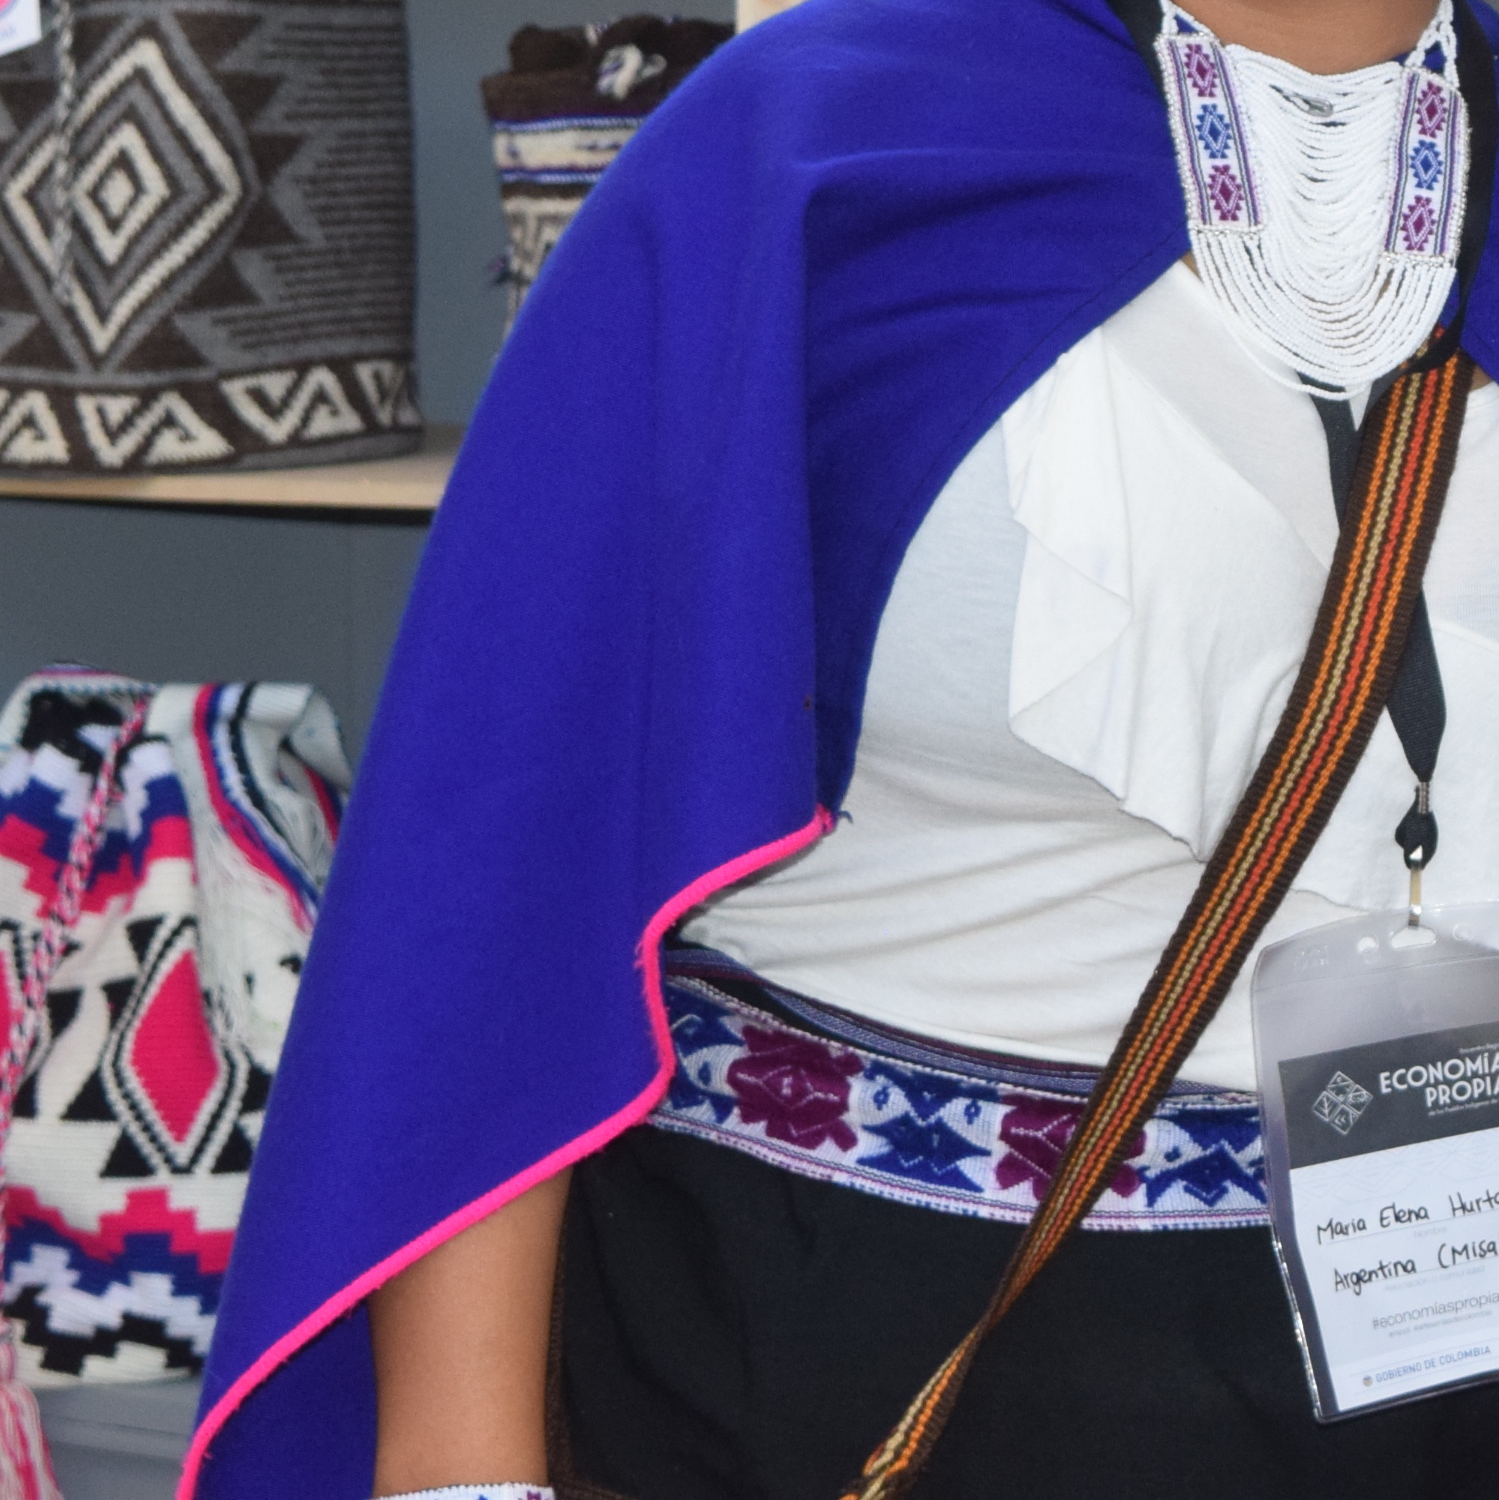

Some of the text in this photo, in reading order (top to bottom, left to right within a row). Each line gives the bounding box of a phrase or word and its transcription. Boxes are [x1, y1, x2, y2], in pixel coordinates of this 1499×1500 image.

[1317, 1217, 1368, 1245] Maria
[1379, 1202, 1431, 1228] Elena
[1334, 1259, 1418, 1296] Argentina
[1376, 1346, 1491, 1382] GOBIERNO DE COLOMBIA
